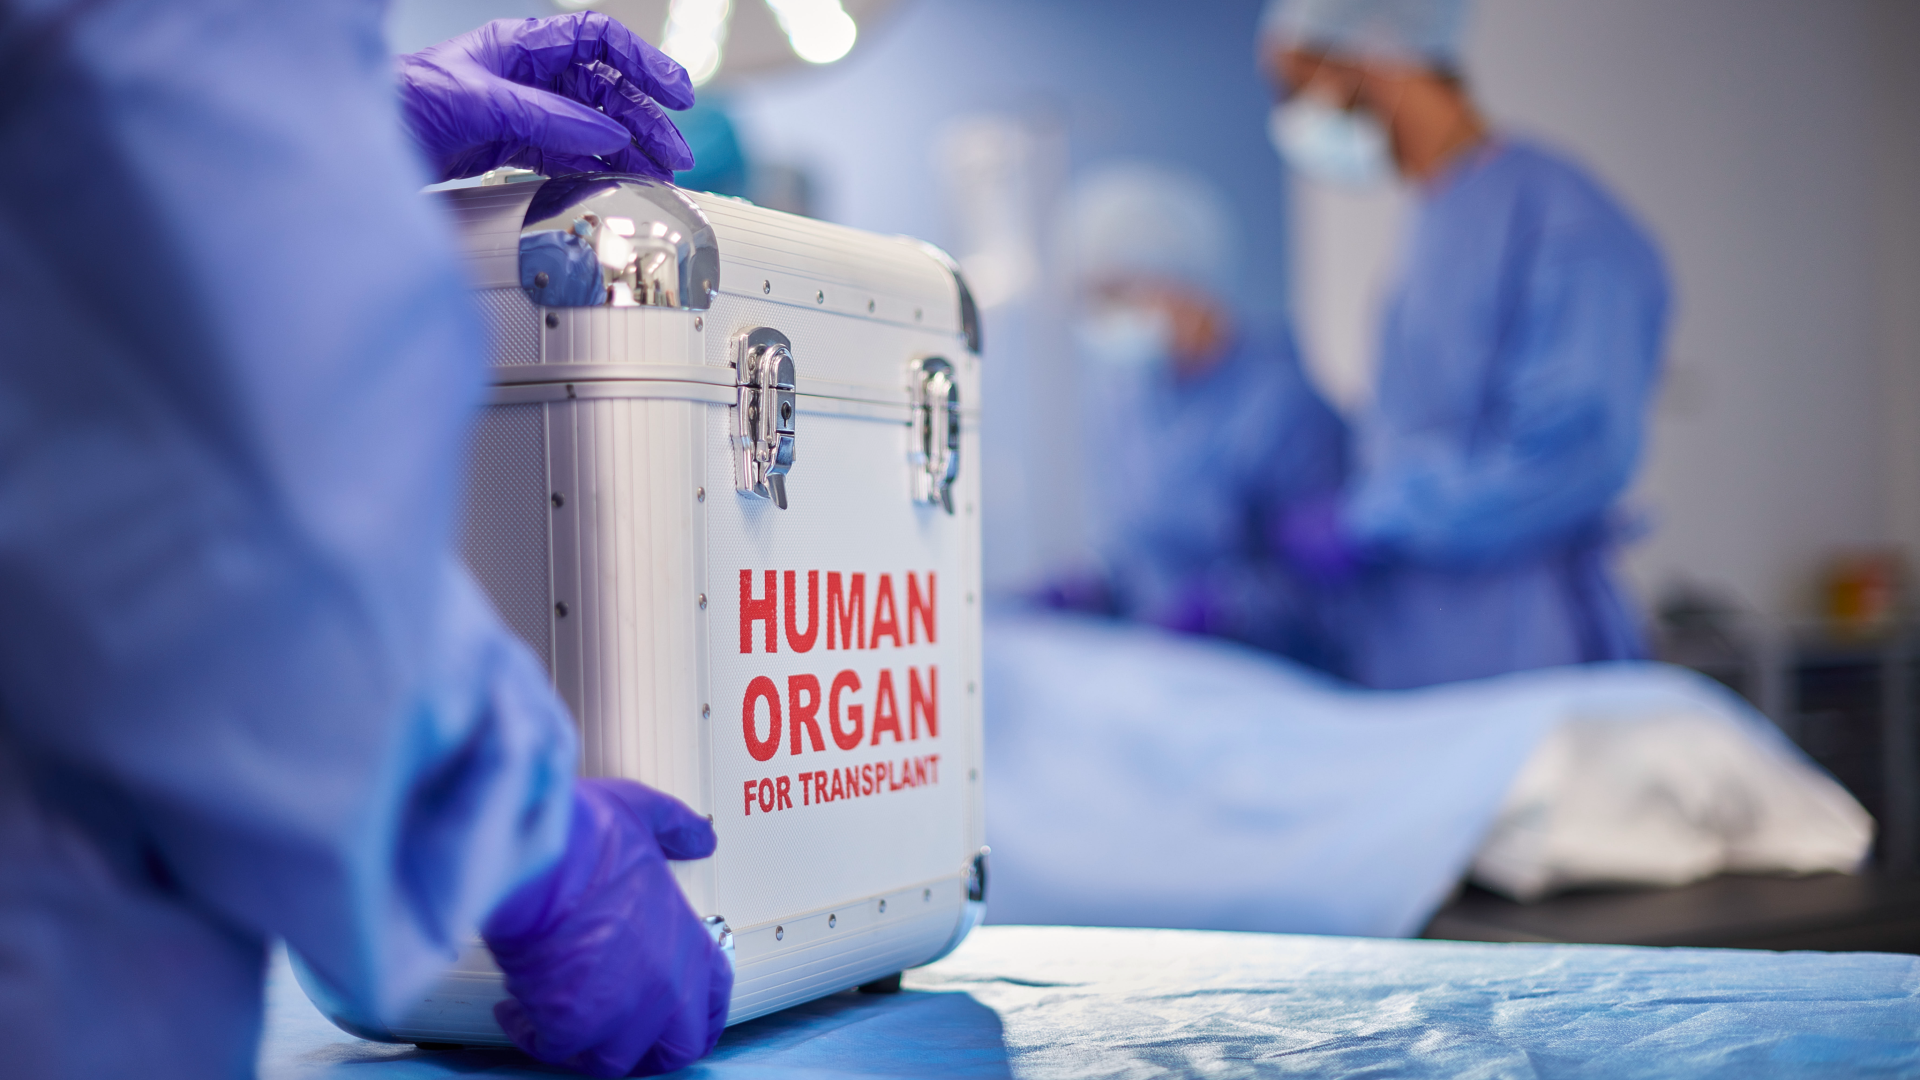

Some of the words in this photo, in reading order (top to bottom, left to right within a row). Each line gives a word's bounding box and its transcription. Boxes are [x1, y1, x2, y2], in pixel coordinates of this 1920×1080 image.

[739, 569, 937, 654] HUMAN
[742, 664, 938, 762] ORGAN
[744, 774, 793, 816] FOR
[798, 753, 941, 807] TRANSPLANT
